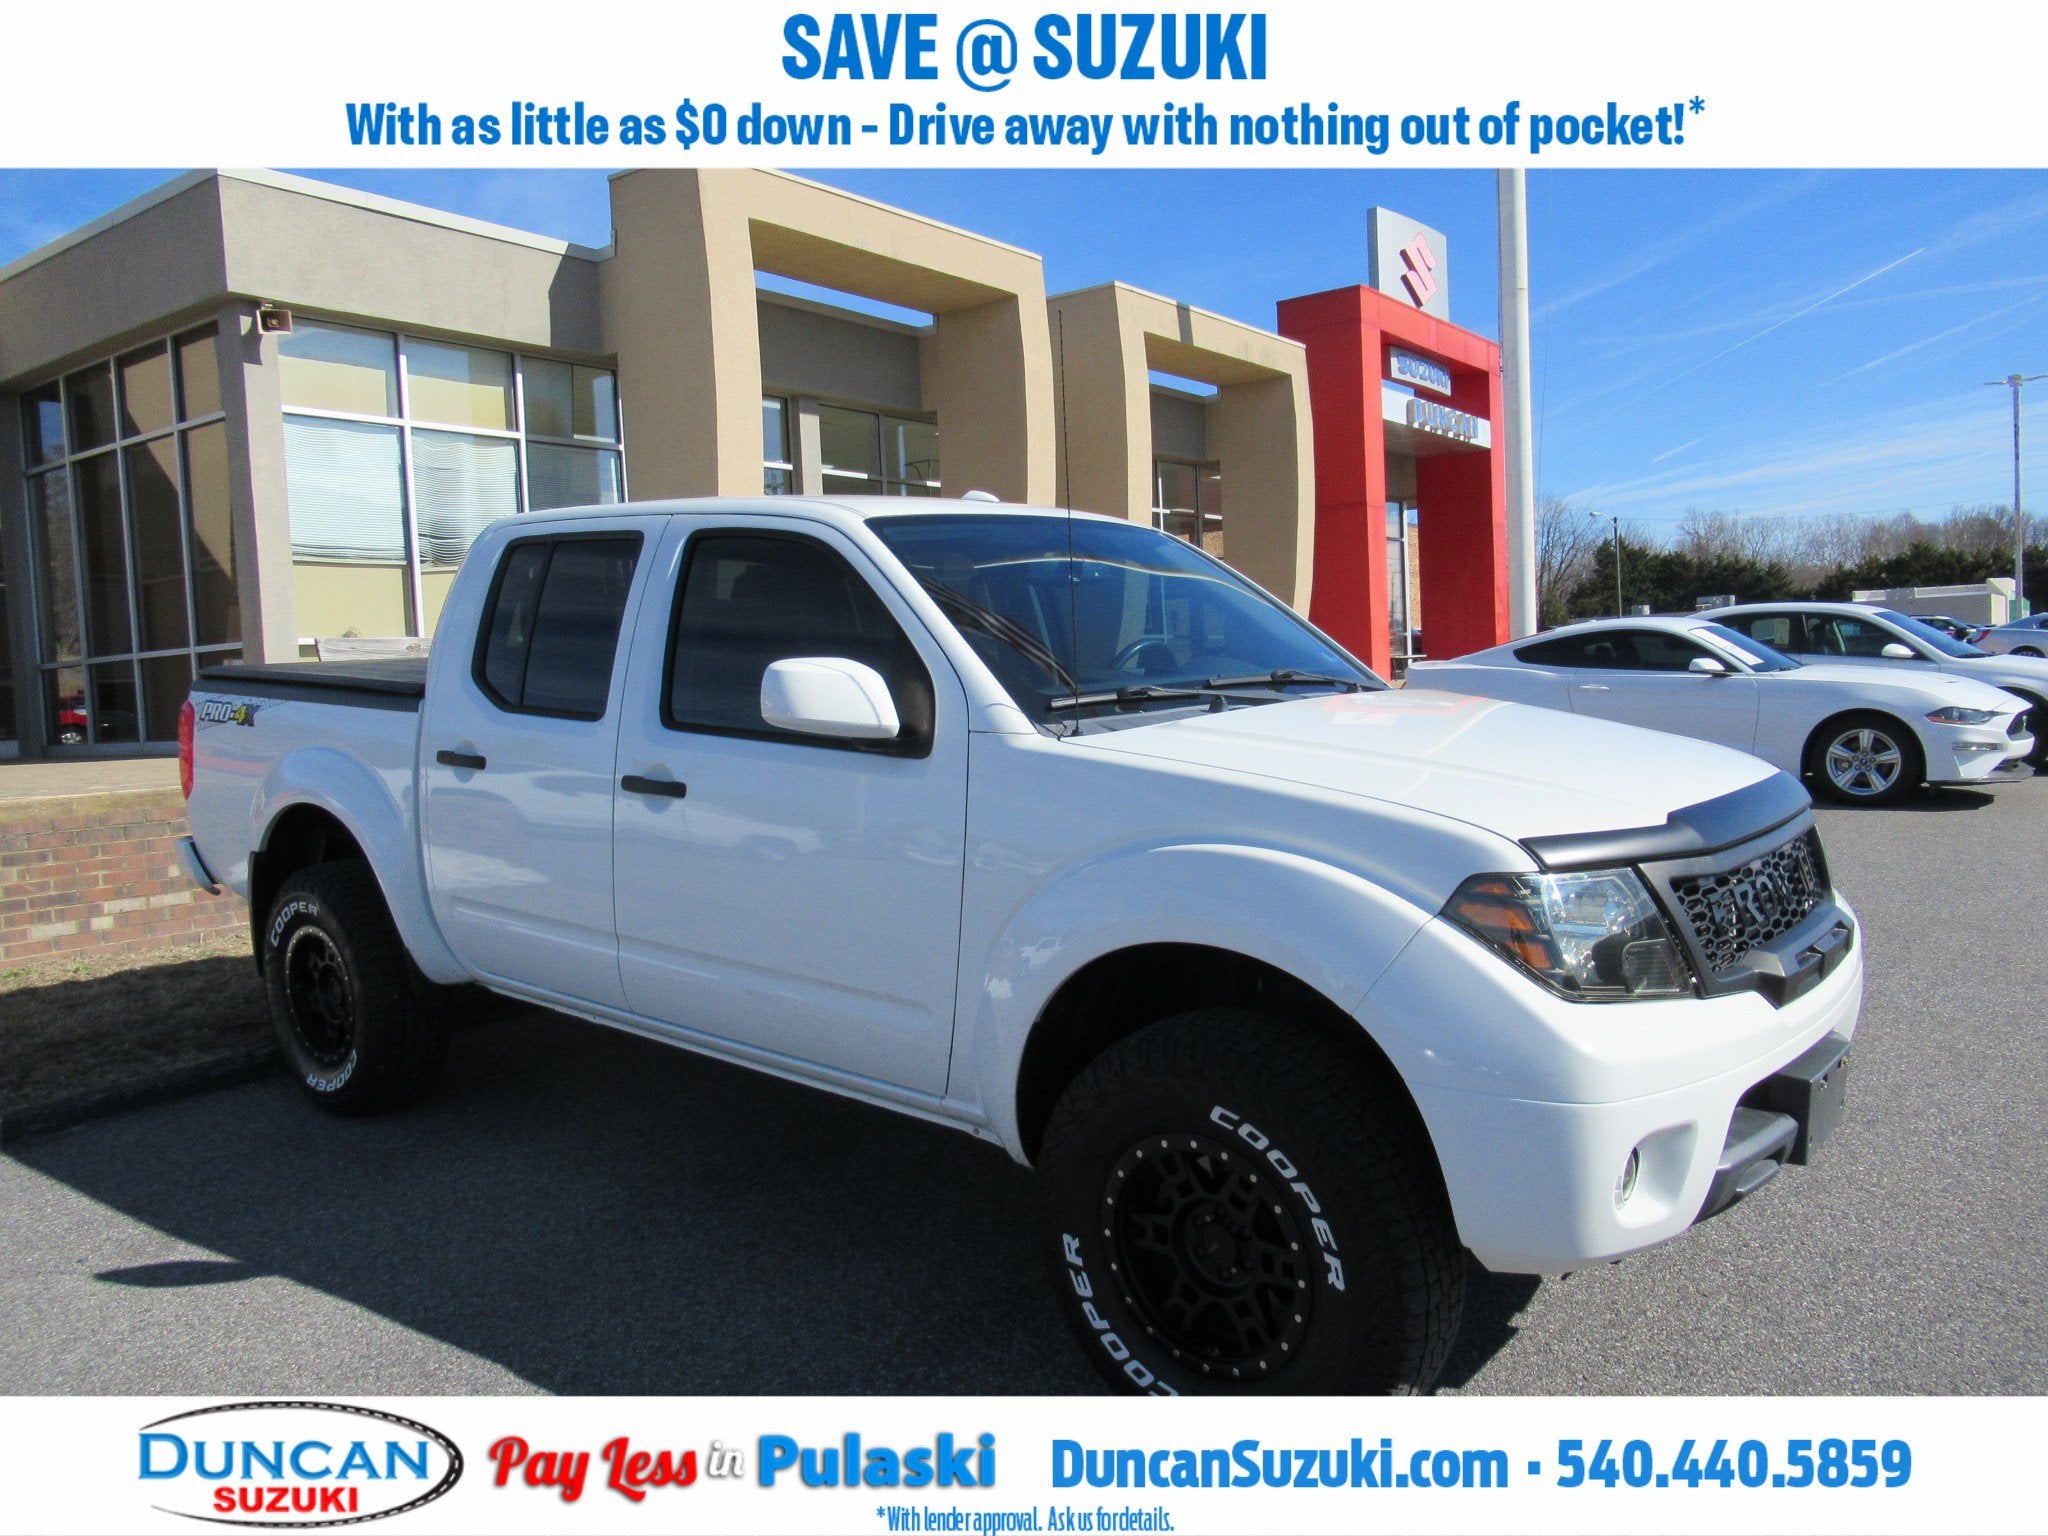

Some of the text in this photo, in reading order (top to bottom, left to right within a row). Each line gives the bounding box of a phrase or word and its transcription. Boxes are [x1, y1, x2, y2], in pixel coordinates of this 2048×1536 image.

[270, 901, 320, 948] COOPER
[305, 1049, 357, 1092] COOPER
[1210, 1105, 1345, 1291] COOPER
